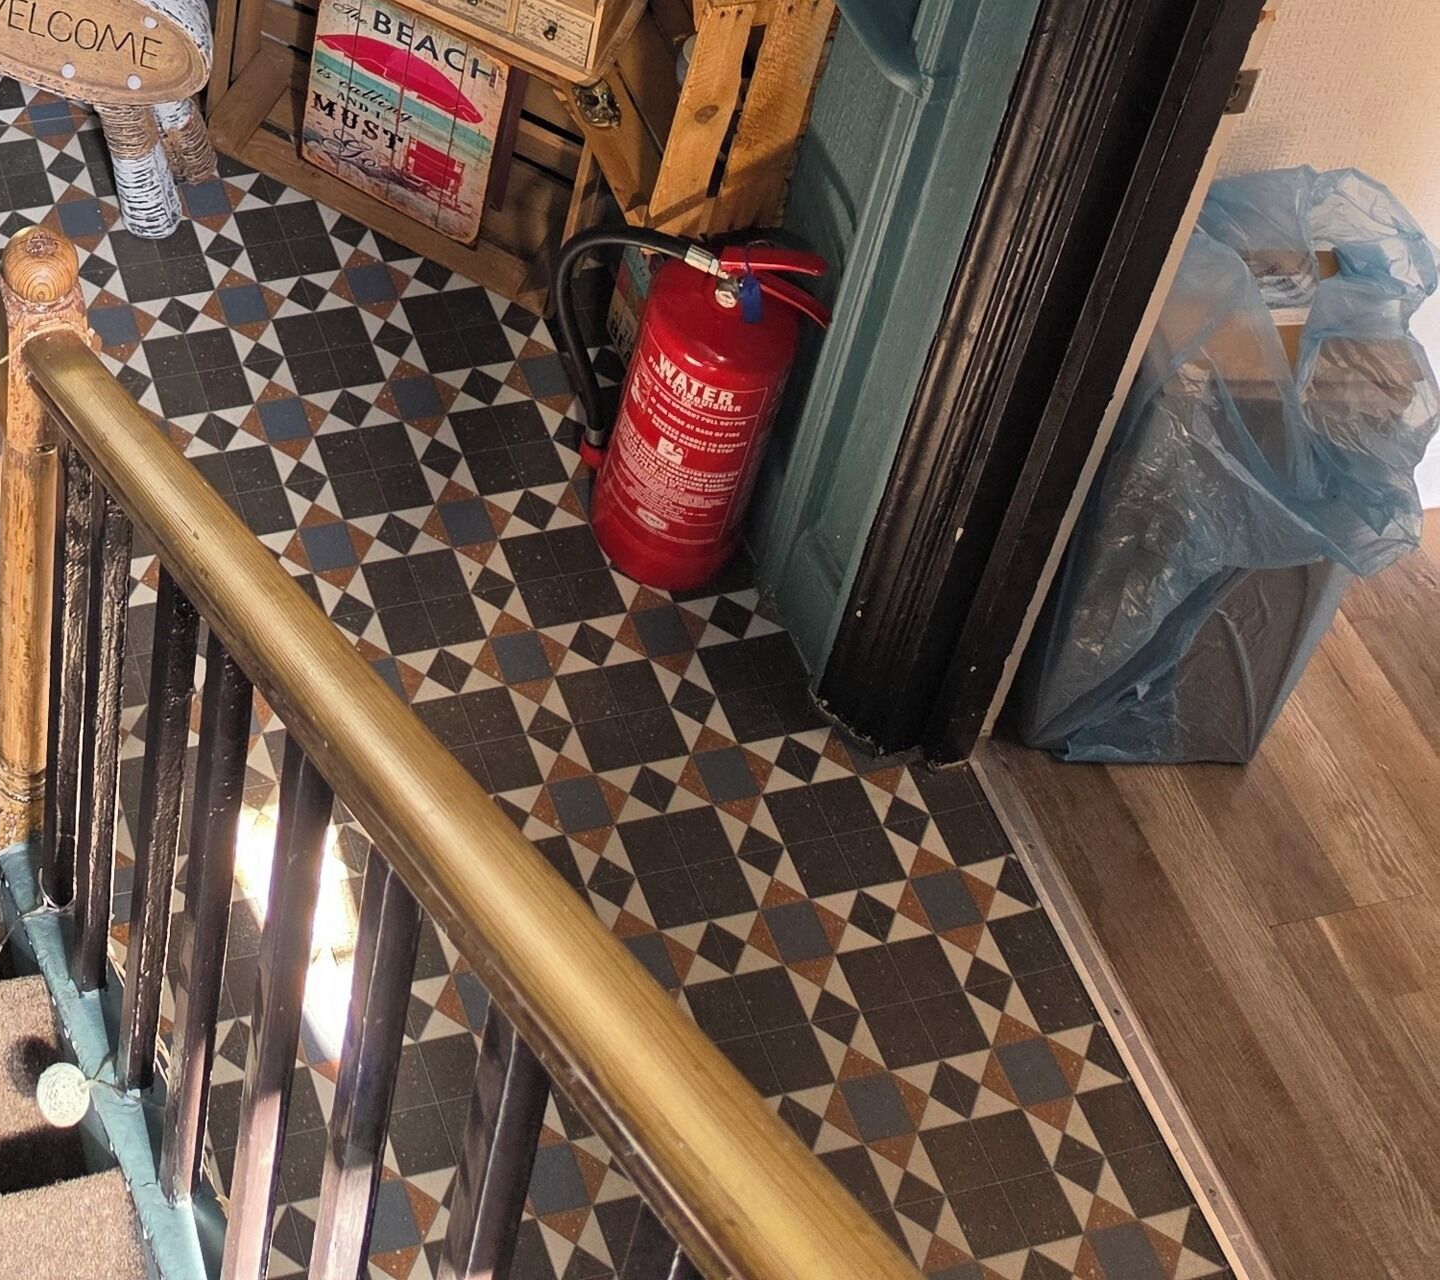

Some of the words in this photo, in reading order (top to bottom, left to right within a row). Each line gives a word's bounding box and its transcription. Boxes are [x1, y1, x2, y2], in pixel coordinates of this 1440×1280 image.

[333, 2, 368, 26] The
[372, 10, 499, 89] BEACH
[310, 90, 405, 152] MUST
[316, 67, 332, 80] is
[338, 79, 413, 124] calling
[336, 91, 369, 113] AND
[375, 112, 381, 120] I
[321, 129, 377, 168] Go
[659, 352, 735, 406] WATER
